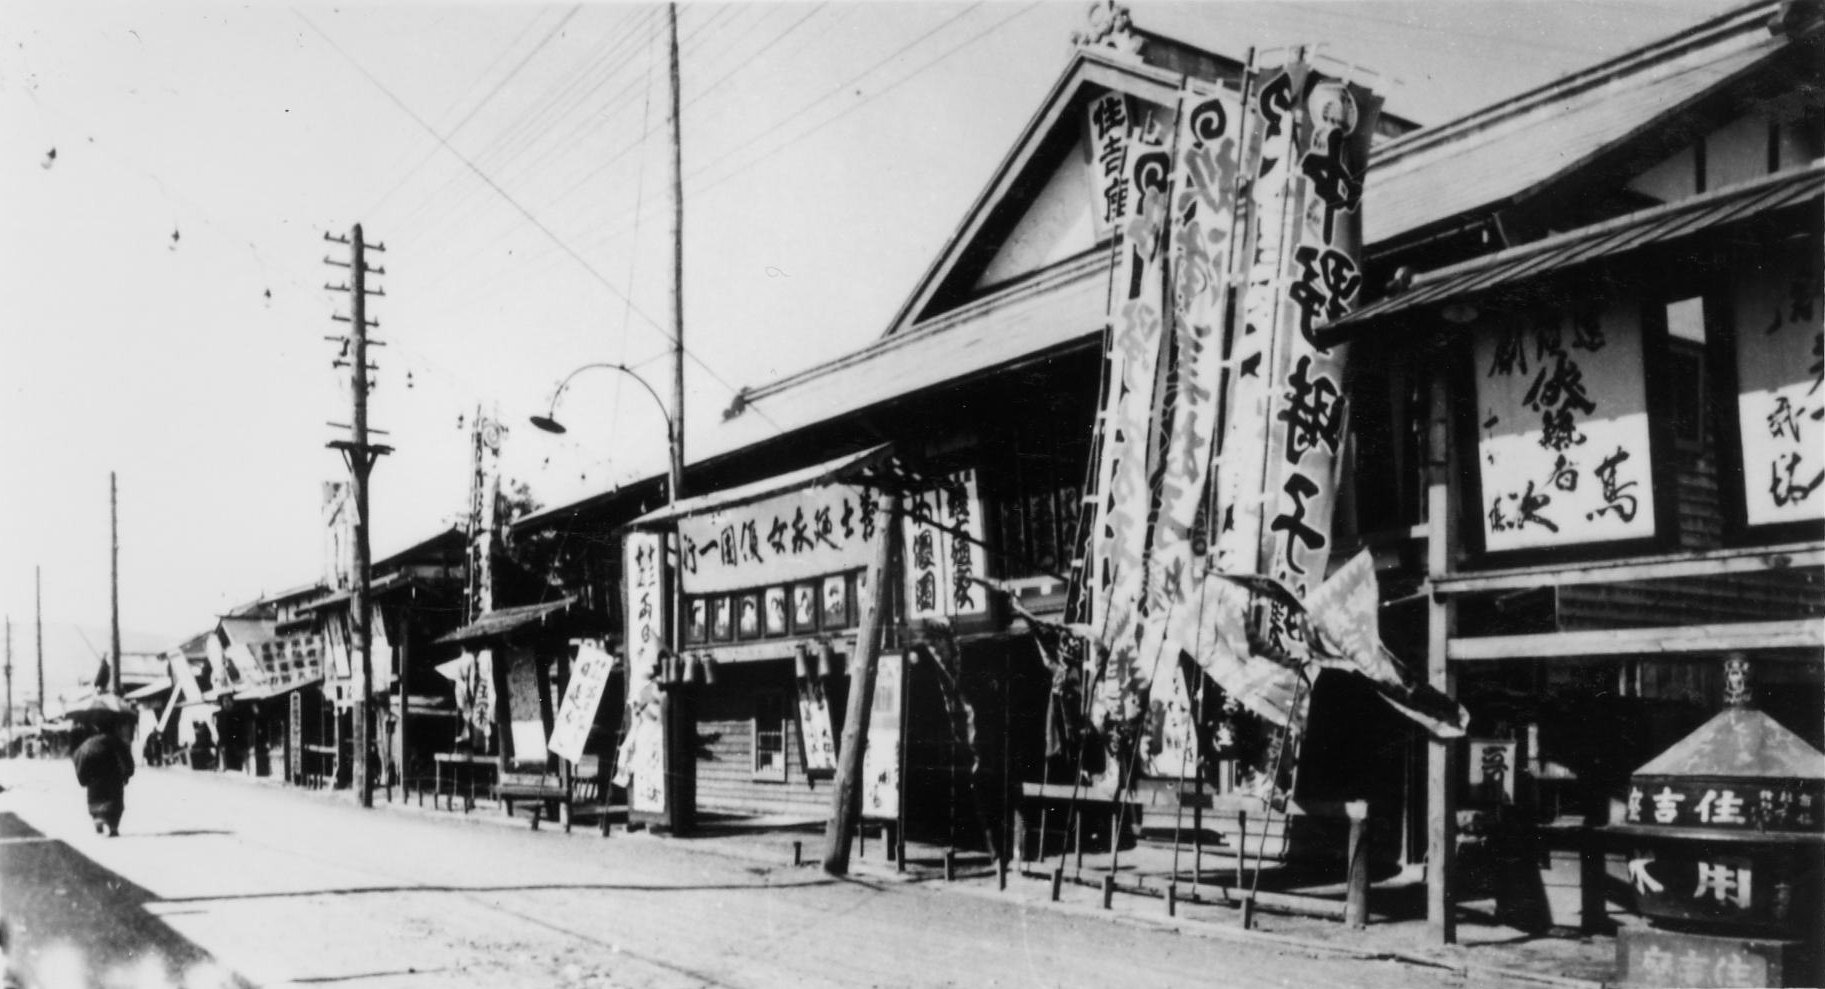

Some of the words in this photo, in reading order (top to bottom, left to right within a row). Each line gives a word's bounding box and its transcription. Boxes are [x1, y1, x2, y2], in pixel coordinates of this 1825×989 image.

[1092, 96, 1129, 222] 住吉座
[1628, 786, 1746, 824] 住吉座
